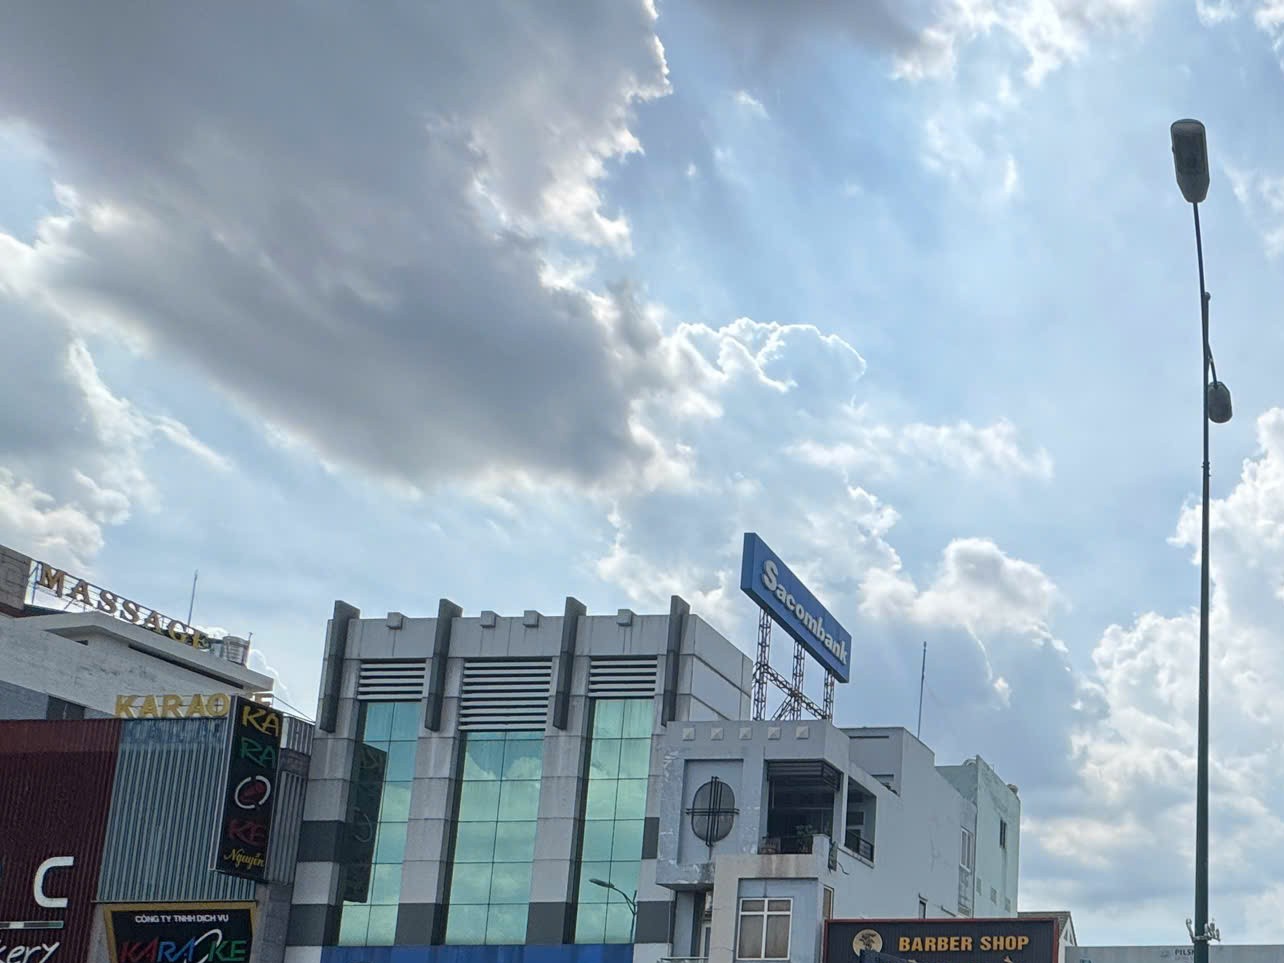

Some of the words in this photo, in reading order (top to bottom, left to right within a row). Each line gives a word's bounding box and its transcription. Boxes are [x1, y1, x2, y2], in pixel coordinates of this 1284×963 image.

[37, 561, 213, 651] MASSAGE
[762, 560, 848, 665] Sacombank
[115, 692, 231, 718] KARAO
[162, 914, 172, 923] TY
[899, 936, 973, 952] BARBER
[979, 935, 1030, 951] SHOP
